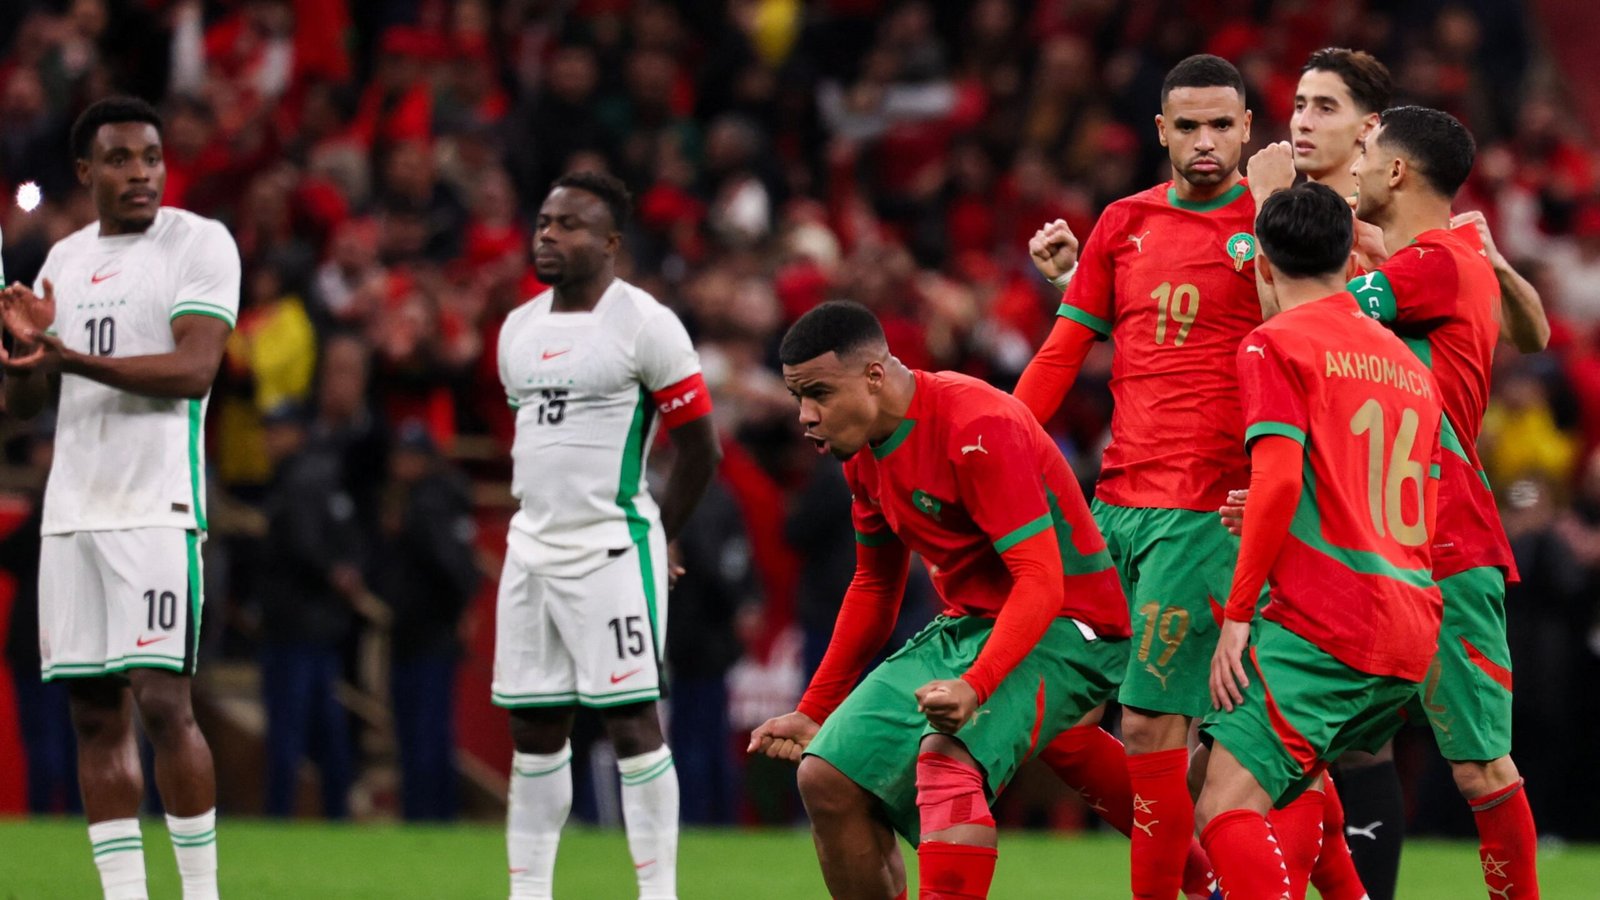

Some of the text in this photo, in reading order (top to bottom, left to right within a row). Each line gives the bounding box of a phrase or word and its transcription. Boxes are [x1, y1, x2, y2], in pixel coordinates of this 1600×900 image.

[85, 316, 115, 356] 10
[1150, 282, 1200, 347] 19
[1325, 351, 1433, 401] AKHOMACH
[538, 389, 569, 425] 15
[660, 389, 698, 414] CAF
[1350, 398, 1429, 547] 16
[143, 589, 177, 631] 10
[608, 615, 646, 660] 15
[1137, 601, 1189, 666] 19
